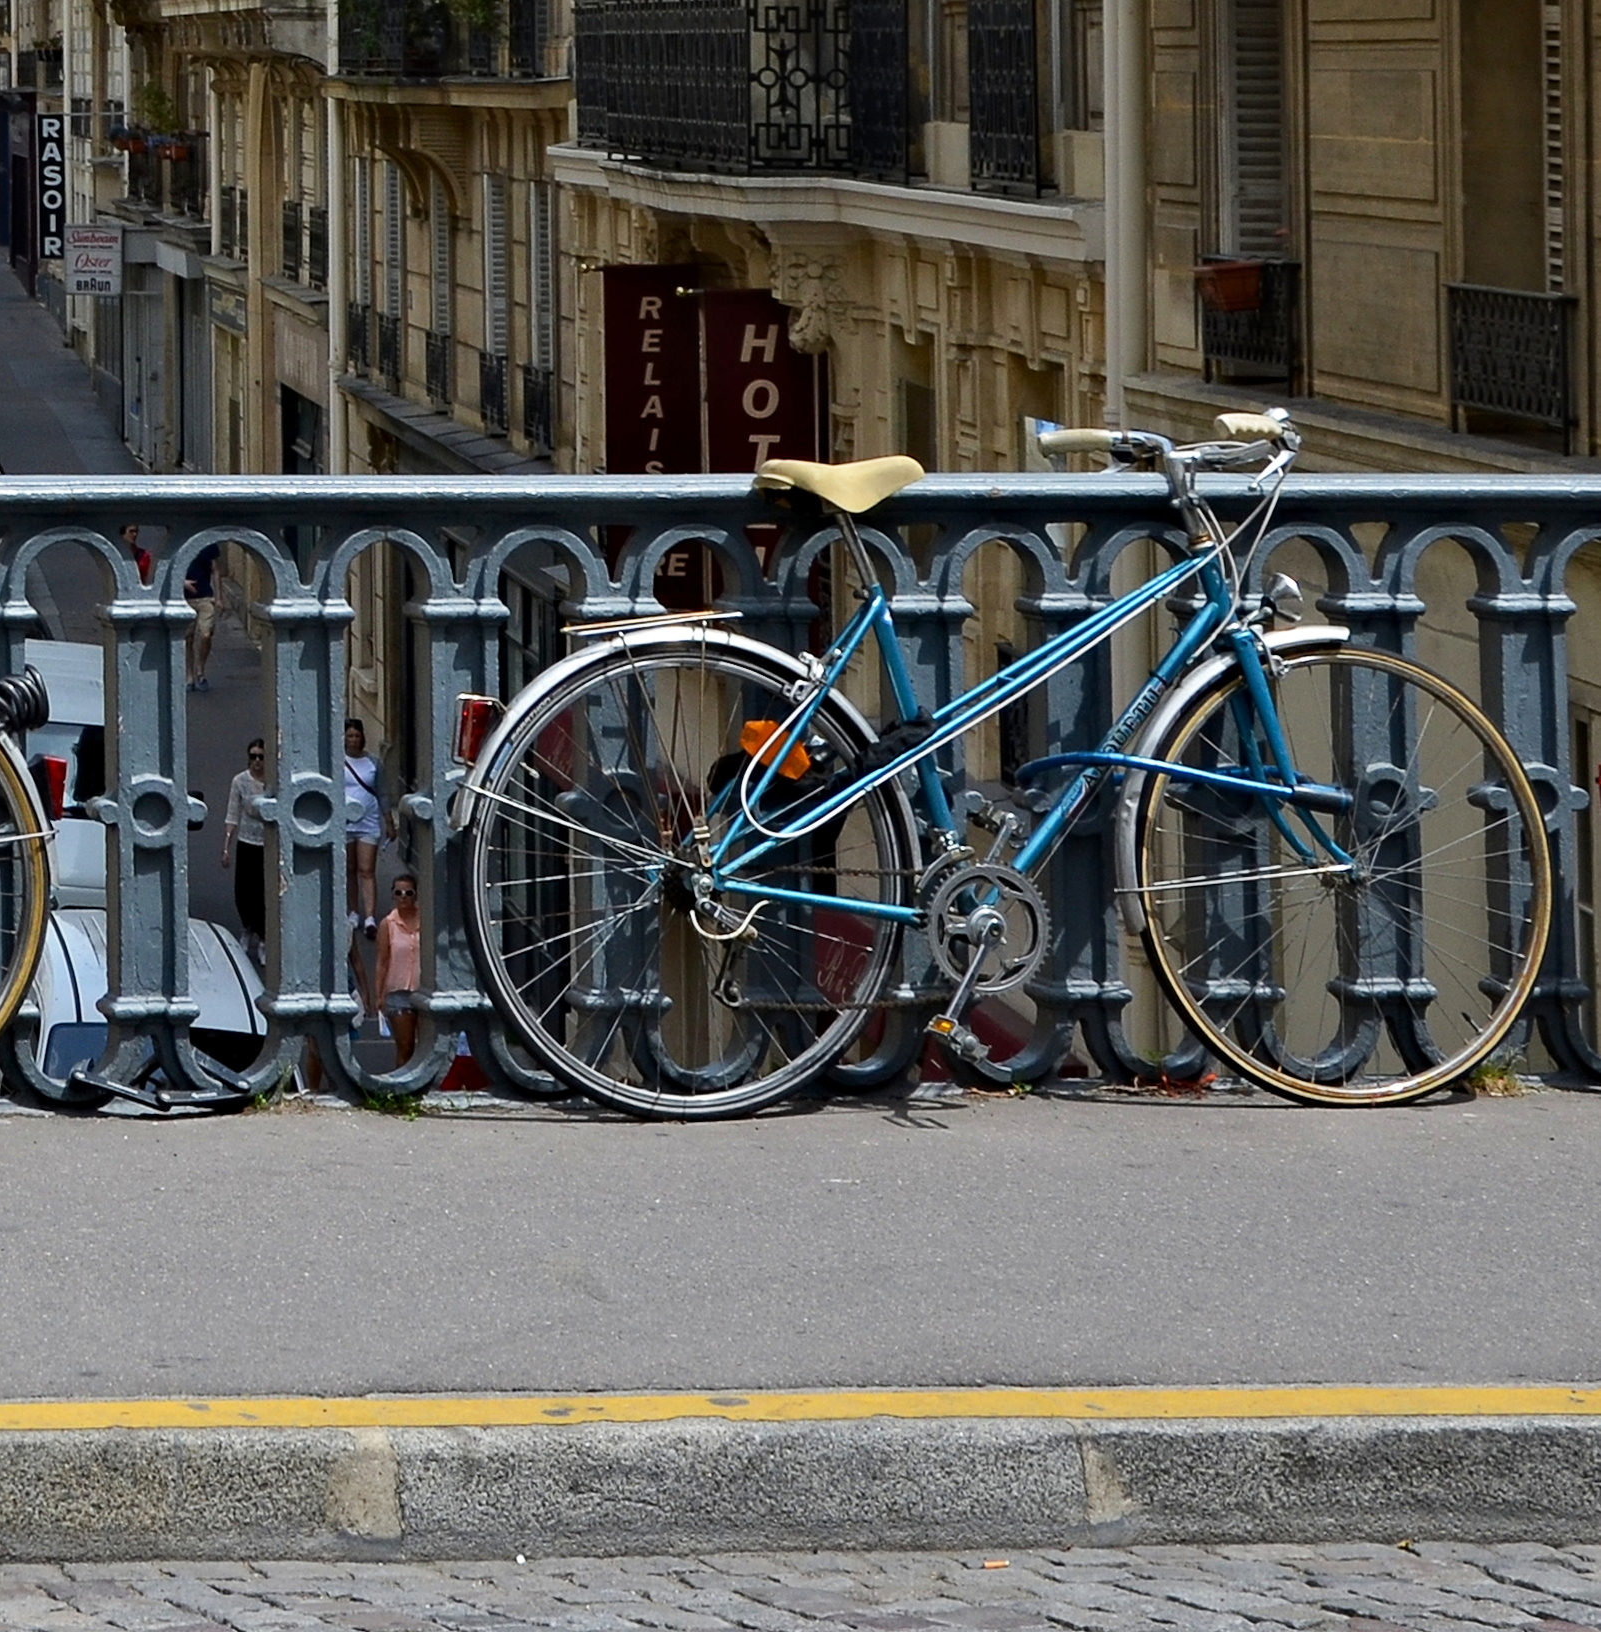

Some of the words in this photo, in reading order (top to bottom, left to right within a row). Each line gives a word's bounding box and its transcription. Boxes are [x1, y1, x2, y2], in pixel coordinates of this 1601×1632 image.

[41, 118, 63, 256] RASOIR
[67, 229, 119, 244] Sunbeam
[74, 252, 113, 270] Oster
[76, 277, 112, 292] BRAUN
